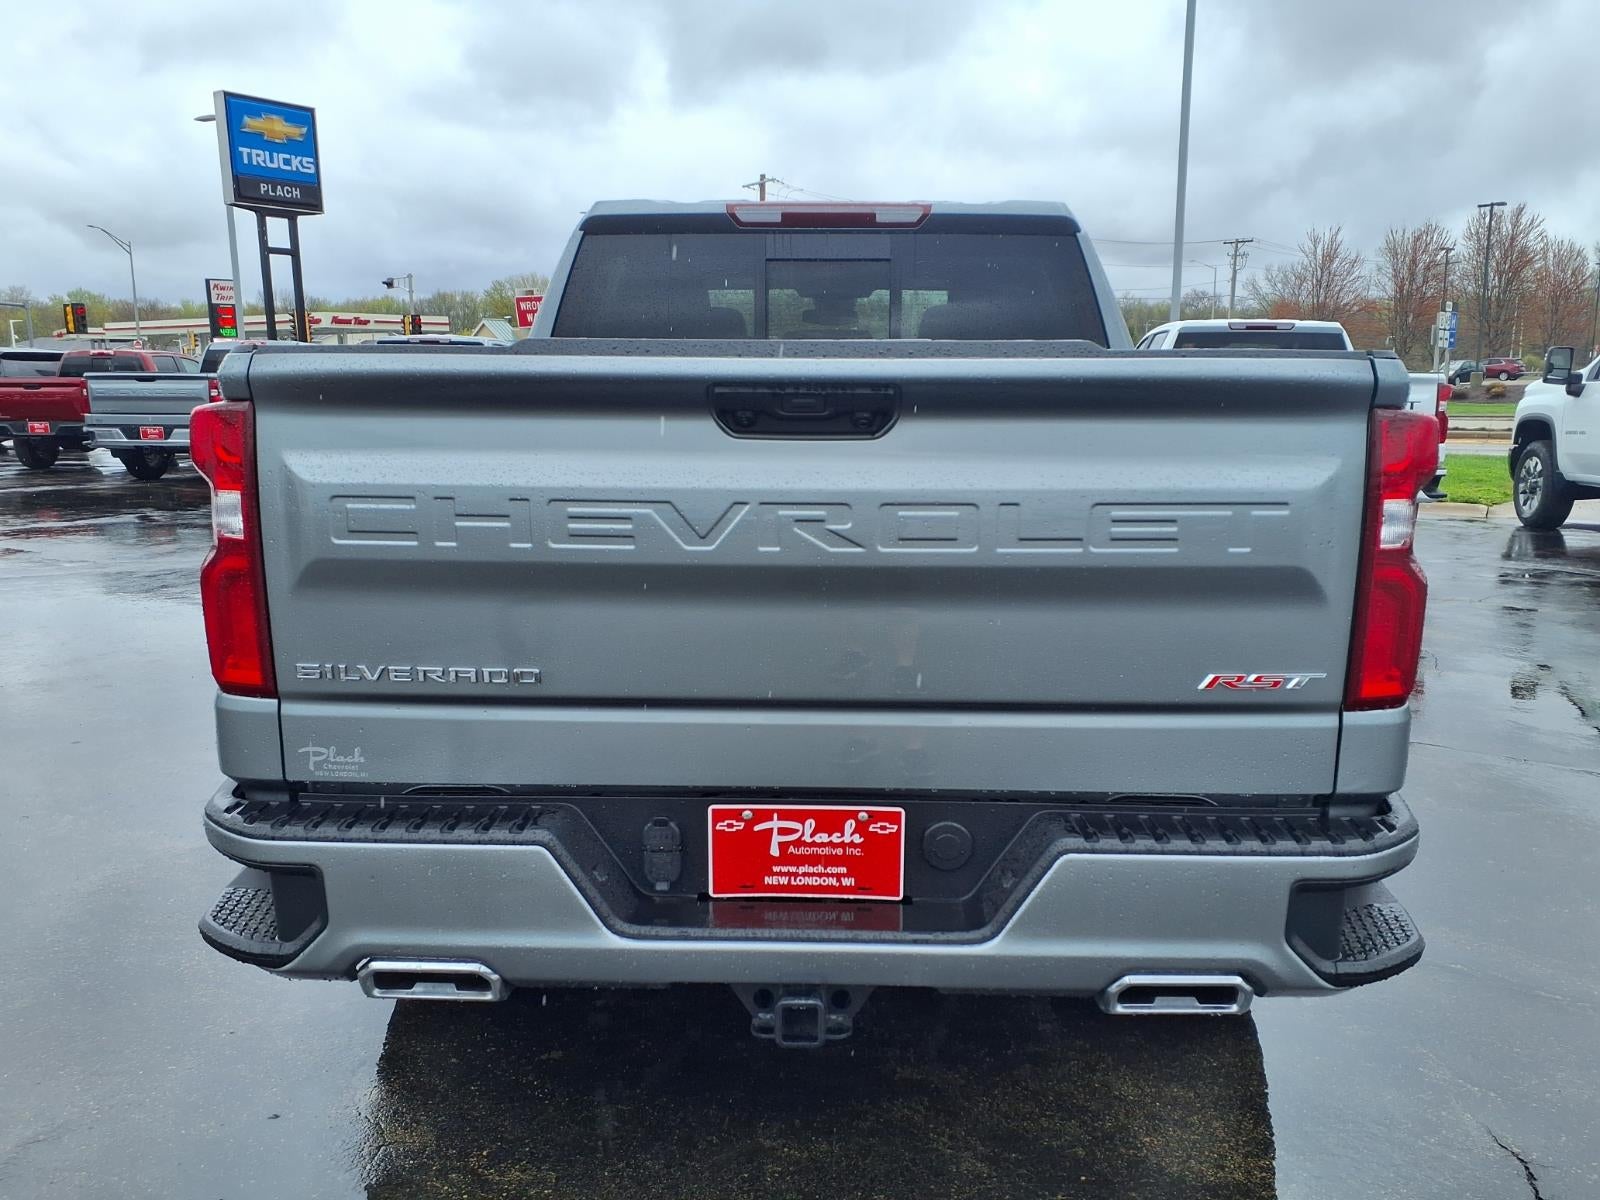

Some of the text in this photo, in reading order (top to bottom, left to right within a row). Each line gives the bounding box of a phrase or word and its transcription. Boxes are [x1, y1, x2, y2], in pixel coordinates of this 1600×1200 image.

[238, 146, 315, 174] TRUCKS
[260, 183, 301, 198] PLACH
[520, 301, 540, 310] WRO
[330, 495, 1290, 554] CHEVROLET
[295, 663, 542, 684] SILVERADO
[1197, 673, 1327, 690] RST
[298, 740, 365, 771] Plach
[753, 812, 864, 857] Plach
[787, 845, 864, 856] Automotive Inc.
[772, 864, 847, 875] www.plach.com
[764, 876, 855, 887] NEW LONDON, WI
